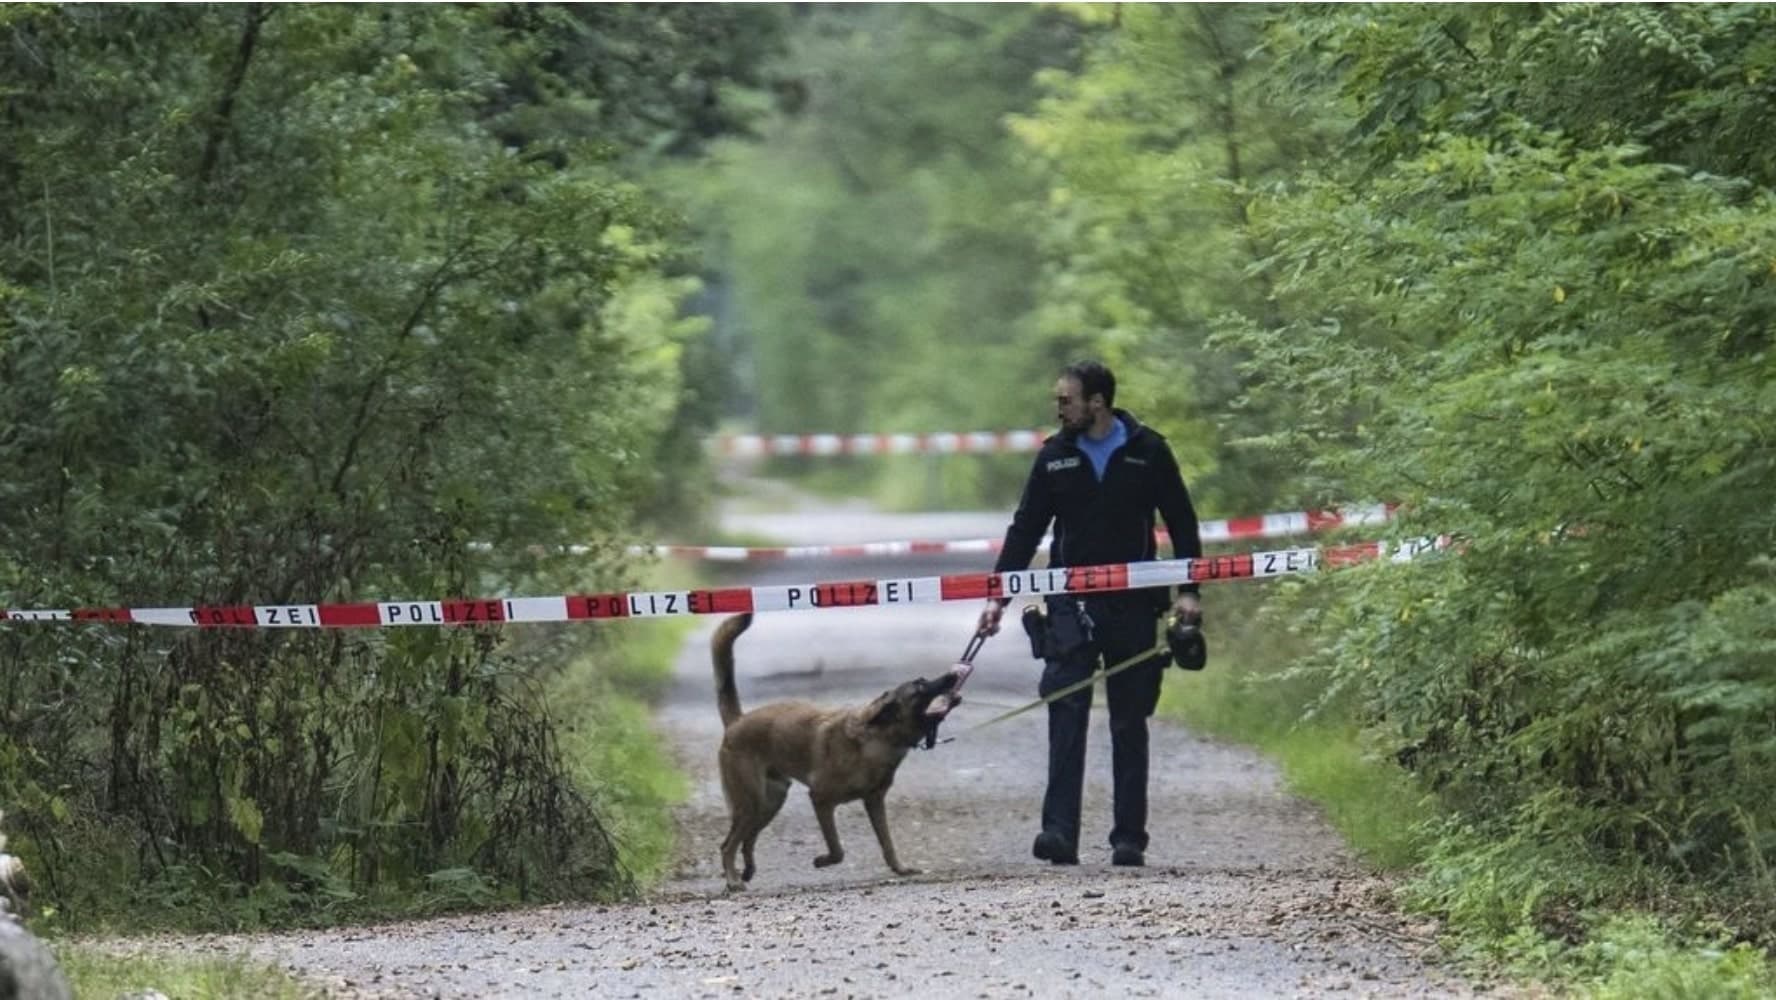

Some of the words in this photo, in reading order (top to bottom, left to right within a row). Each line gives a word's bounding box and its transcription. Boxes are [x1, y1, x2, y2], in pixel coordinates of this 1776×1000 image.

[387, 601, 514, 623] POLIZEI
[586, 593, 714, 617] POLIZEI
[787, 580, 914, 609] POLIZEI
[986, 565, 1113, 597] POLIZEI
